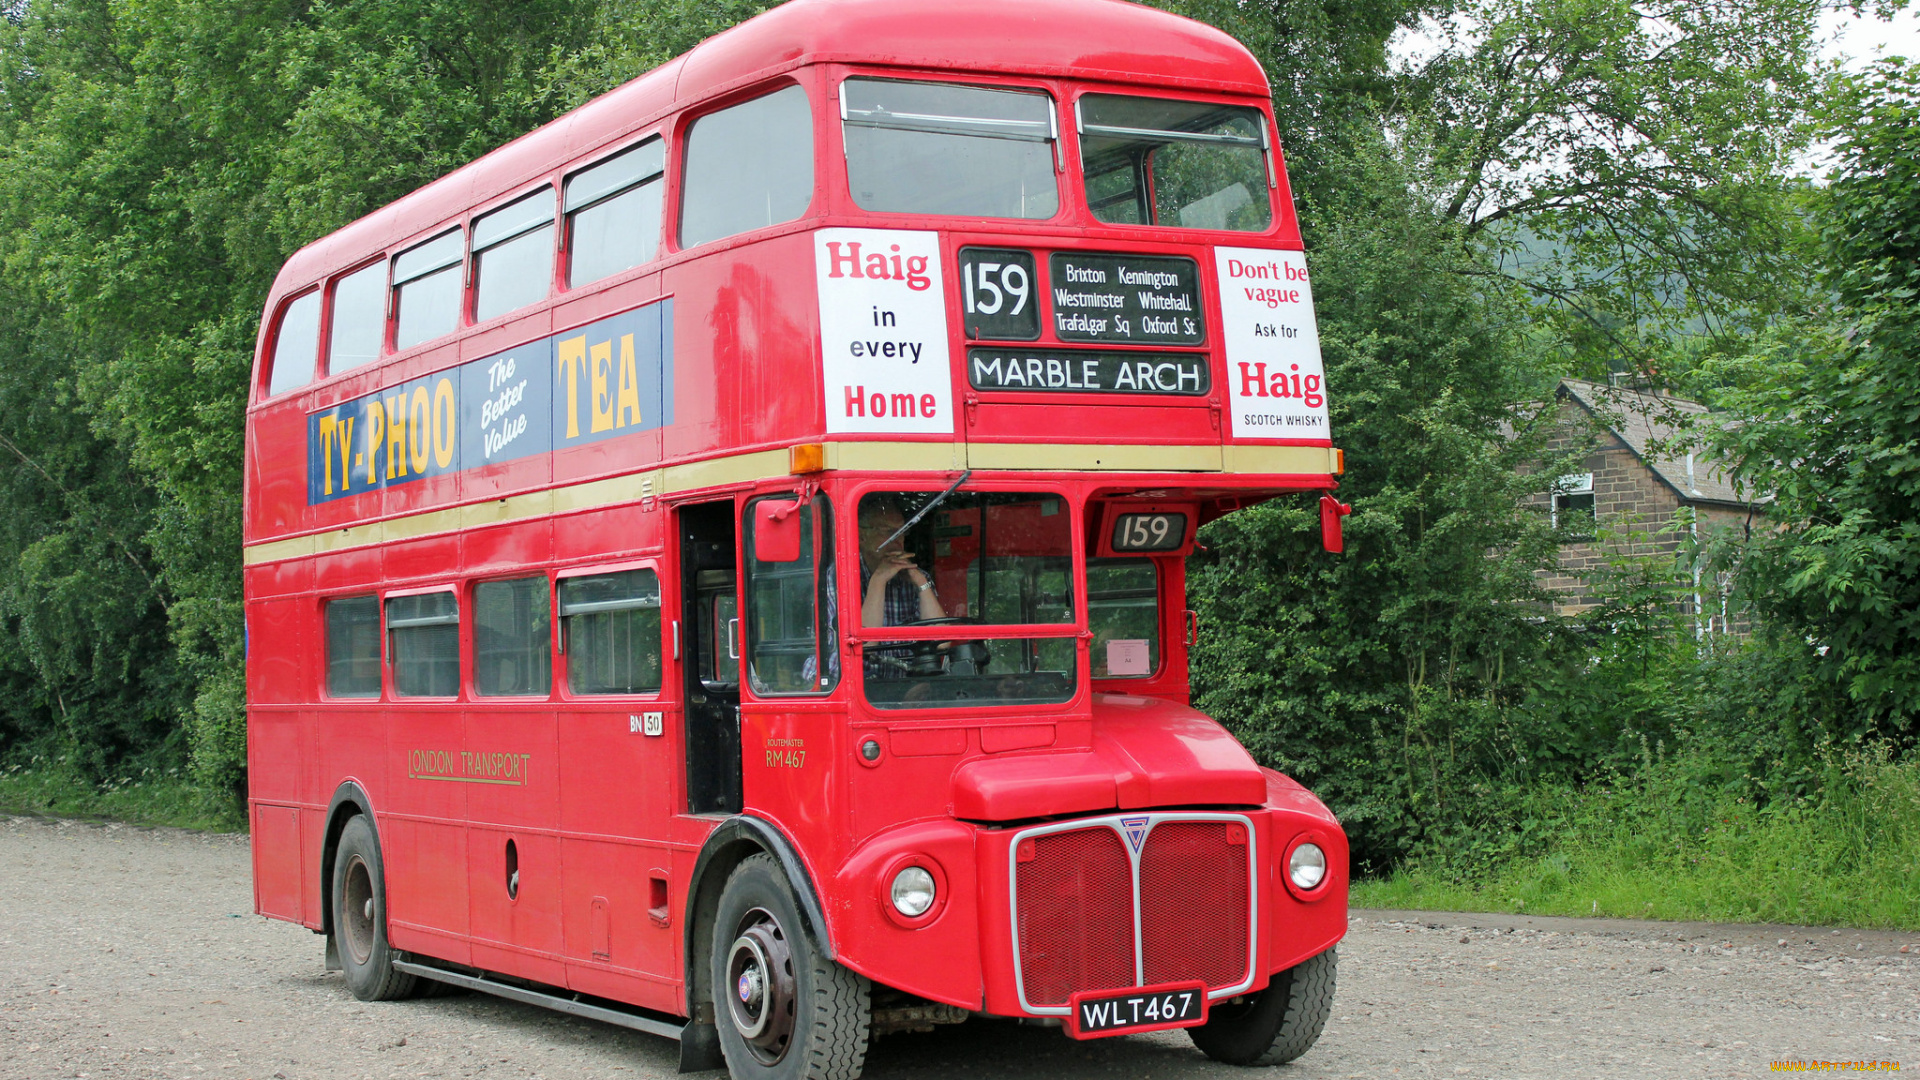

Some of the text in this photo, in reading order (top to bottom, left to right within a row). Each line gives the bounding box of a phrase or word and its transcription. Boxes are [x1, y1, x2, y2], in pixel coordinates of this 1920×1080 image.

[826, 242, 931, 291] Haig
[1066, 263, 1179, 290] Brixton Kennington
[1228, 259, 1307, 282] Don't be
[964, 262, 1029, 316] 159
[1055, 288, 1192, 311] Westminster Whitehall
[1244, 287, 1300, 309] vague
[873, 305, 896, 327] in
[1055, 313, 1197, 337] Trafalgar Sq Oxford St
[1254, 323, 1298, 338] Ask for
[850, 340, 922, 364] every
[488, 356, 516, 393] The
[558, 332, 642, 439] TEA
[973, 357, 1199, 391] MARBLE ARCH
[1237, 361, 1323, 409] Haig
[481, 379, 527, 428] Better
[844, 385, 936, 418] Home
[1244, 414, 1323, 427] SCOTCH WHISKY
[319, 377, 455, 496] TY-PHOO
[484, 413, 527, 459] Value
[1122, 516, 1169, 547] 159
[630, 715, 642, 732] BN
[647, 715, 660, 731] 50
[767, 739, 804, 747] ROUTEMASTER
[408, 749, 530, 786] LONDON TRANSPORT
[766, 750, 806, 768] RM 467
[1083, 993, 1193, 1028] WLT467
